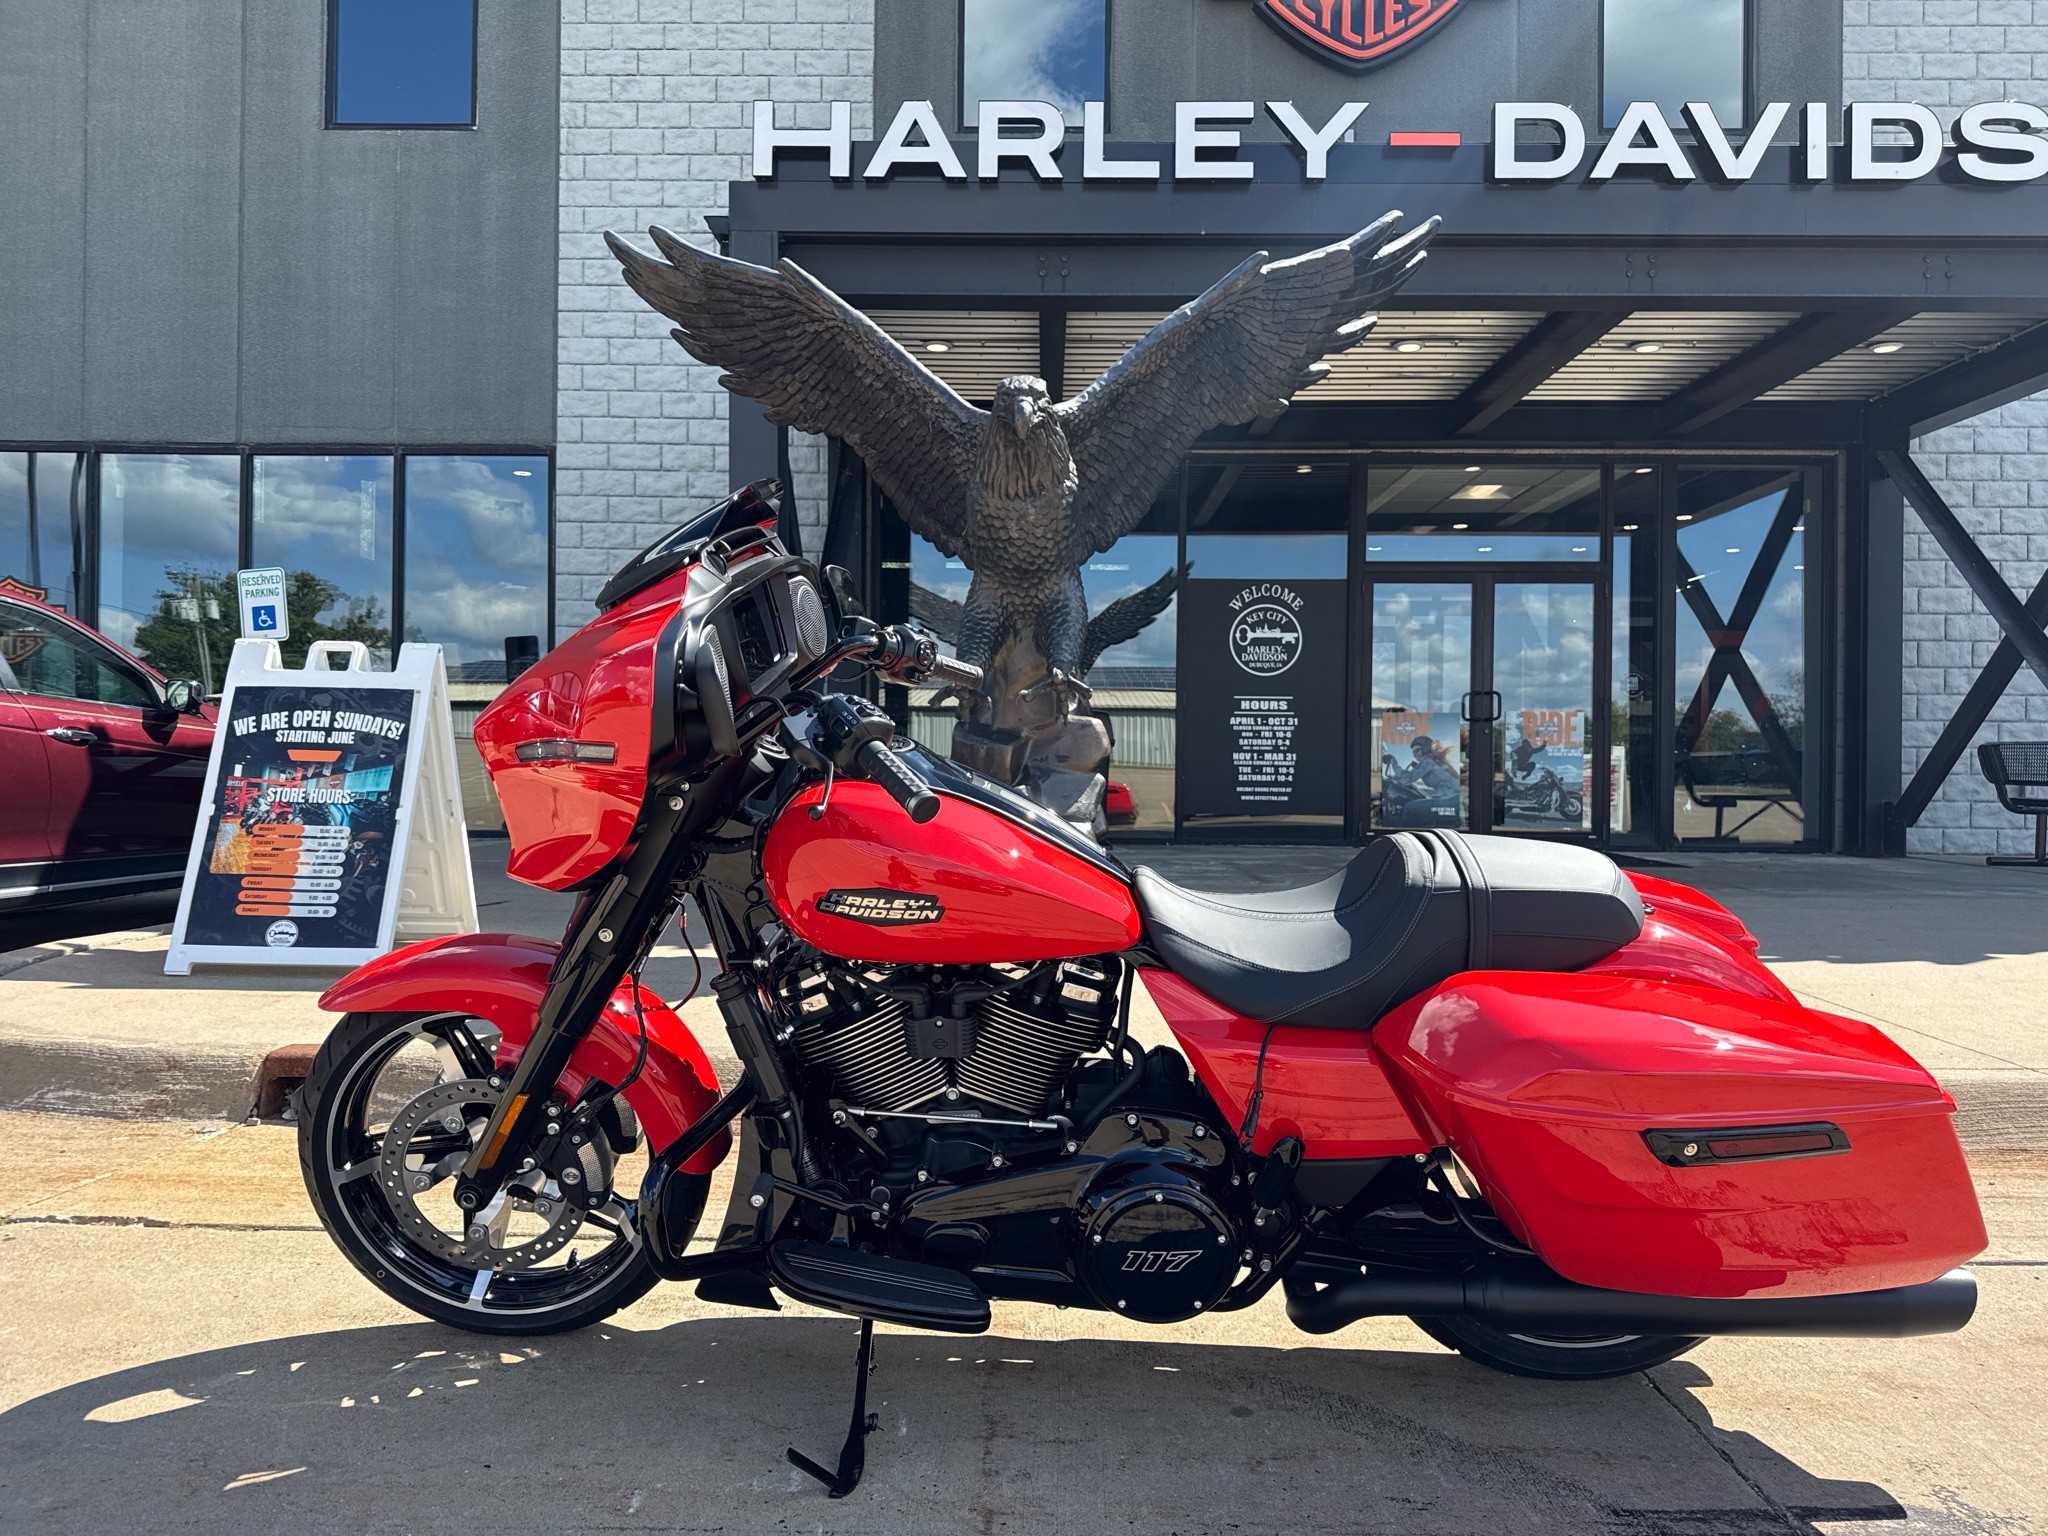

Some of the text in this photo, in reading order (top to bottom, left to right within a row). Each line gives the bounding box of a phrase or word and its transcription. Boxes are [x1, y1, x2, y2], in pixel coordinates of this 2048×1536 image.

[241, 574, 281, 587] RESERVED
[245, 587, 280, 599] PARKING
[1228, 583, 1304, 611] WELCOME
[1245, 611, 1289, 625] KEY CITY
[1246, 645, 1286, 654] HARLEY-
[1241, 653, 1288, 661] DAVIDSON
[1240, 700, 1288, 710] HOURS
[233, 709, 406, 740] WE ARE OPEN SUNDAYS!
[1229, 717, 1255, 725] APRIL
[1256, 717, 1261, 725] 1
[1267, 717, 1286, 725] OCT
[1287, 717, 1298, 725] 31
[275, 730, 355, 744] STARTING JUNE
[1232, 752, 1251, 760] NOV
[1285, 753, 1296, 761] 31
[267, 788, 355, 804] STORE HOURS:
[820, 901, 939, 920] DAVIDSON
[1121, 1249, 1203, 1273] 117
